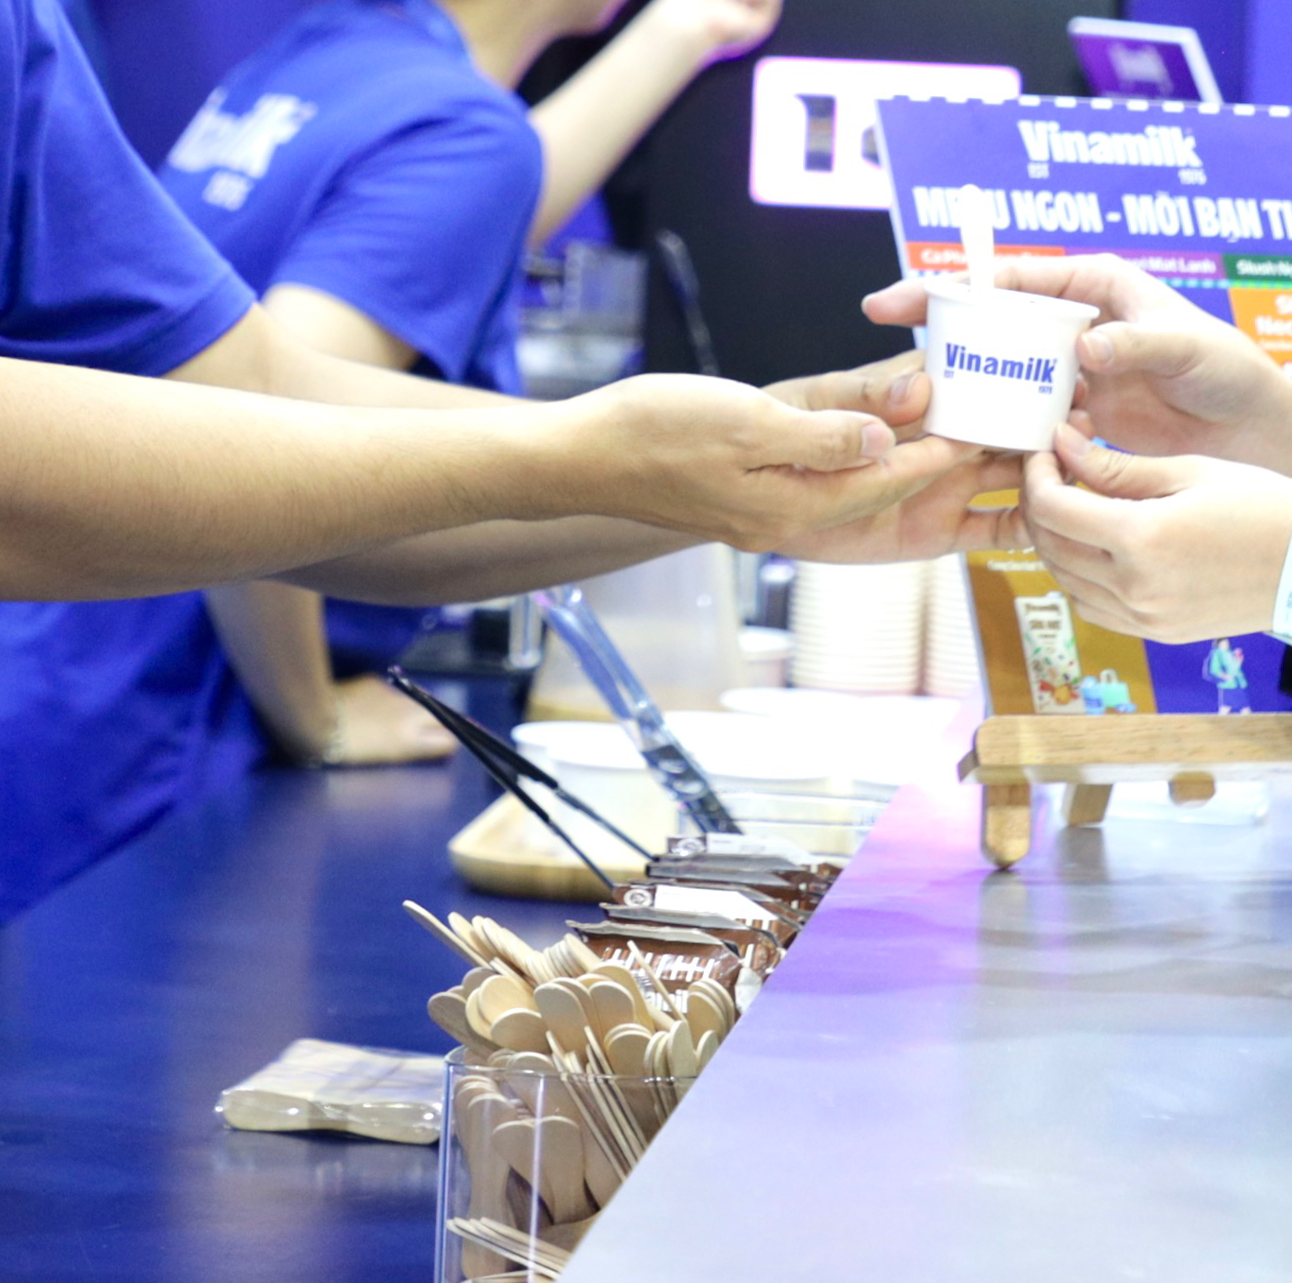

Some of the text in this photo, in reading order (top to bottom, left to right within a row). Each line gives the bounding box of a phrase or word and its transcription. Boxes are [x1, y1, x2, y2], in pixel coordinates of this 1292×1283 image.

[1018, 120, 1203, 167] Vinamilk
[1010, 190, 1104, 233] NGON
[1193, 196, 1264, 243] BẠN
[945, 342, 1055, 384] Vinamilk
